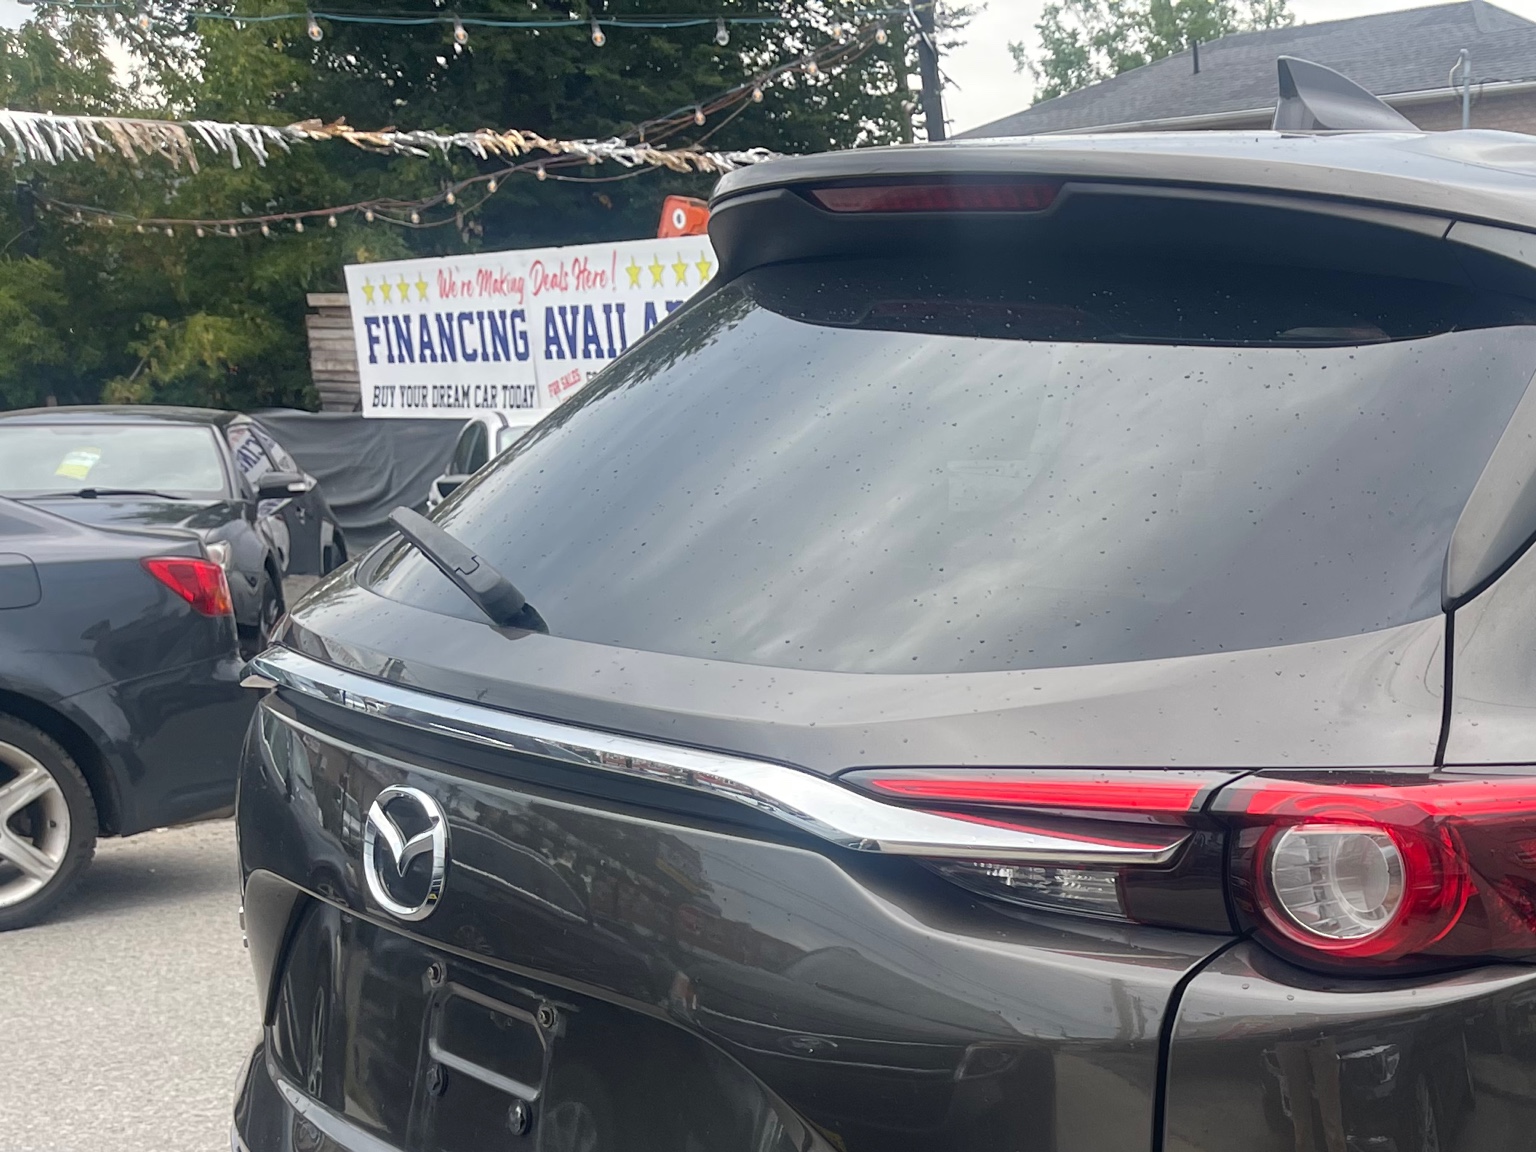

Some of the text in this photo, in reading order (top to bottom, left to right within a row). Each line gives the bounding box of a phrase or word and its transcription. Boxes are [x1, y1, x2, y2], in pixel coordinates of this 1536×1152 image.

[437, 266, 473, 299] We're
[477, 266, 525, 304] Making
[529, 260, 568, 296] Deals
[364, 300, 686, 364] FINANCING AVAILA
[372, 384, 536, 409] BUY YOUR DREAM CAR TODAY
